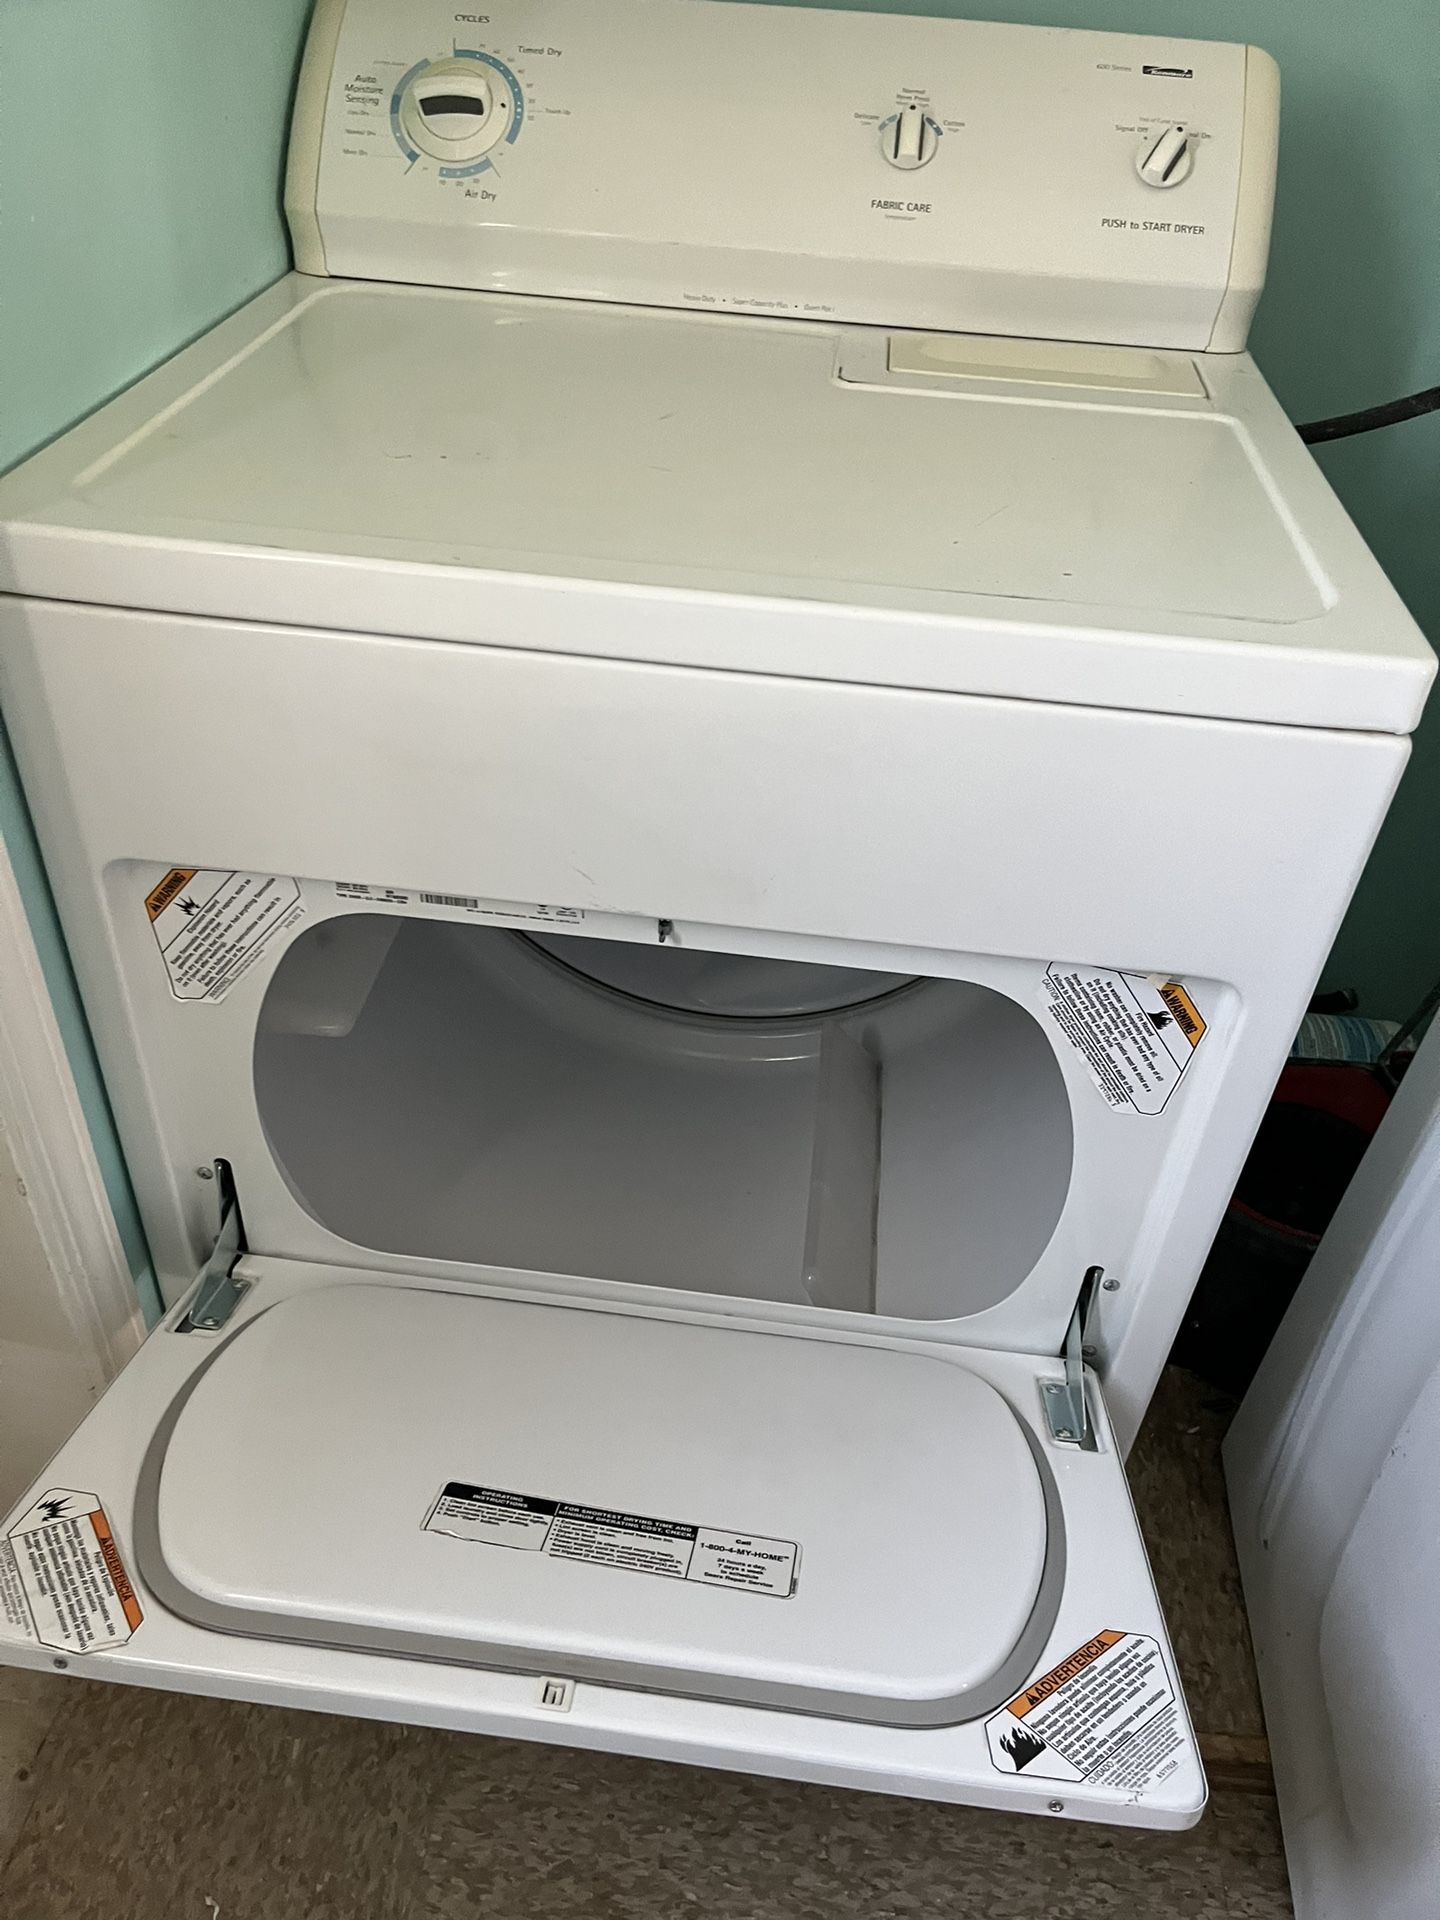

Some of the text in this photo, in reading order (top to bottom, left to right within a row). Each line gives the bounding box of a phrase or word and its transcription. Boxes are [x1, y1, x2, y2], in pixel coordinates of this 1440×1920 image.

[454, 14, 490, 23] CYCLES
[518, 46, 562, 57] Timed Dry
[354, 75, 377, 83] Auto
[345, 84, 384, 94] Moisture
[345, 94, 379, 106] Sensing
[465, 189, 496, 202] Air Dry
[871, 199, 932, 213] FABRIC CARE
[1101, 218, 1127, 228] PUSH
[1142, 221, 1172, 232] START
[1174, 224, 1205, 234] DRYER
[152, 872, 186, 905] WARNING
[1166, 997, 1198, 1033] WARNING
[472, 1494, 528, 1507] INSTRUCTIONS
[481, 1490, 523, 1501] OPERATING
[558, 1510, 594, 1520] MINIMUM
[595, 1516, 639, 1528] OPERATING
[581, 1508, 622, 1520] SHORTEST
[623, 1516, 653, 1525] DRYING
[102, 1541, 132, 1602] ADVERTENCIA
[1034, 1637, 1109, 1697] ADVERTENCIA
